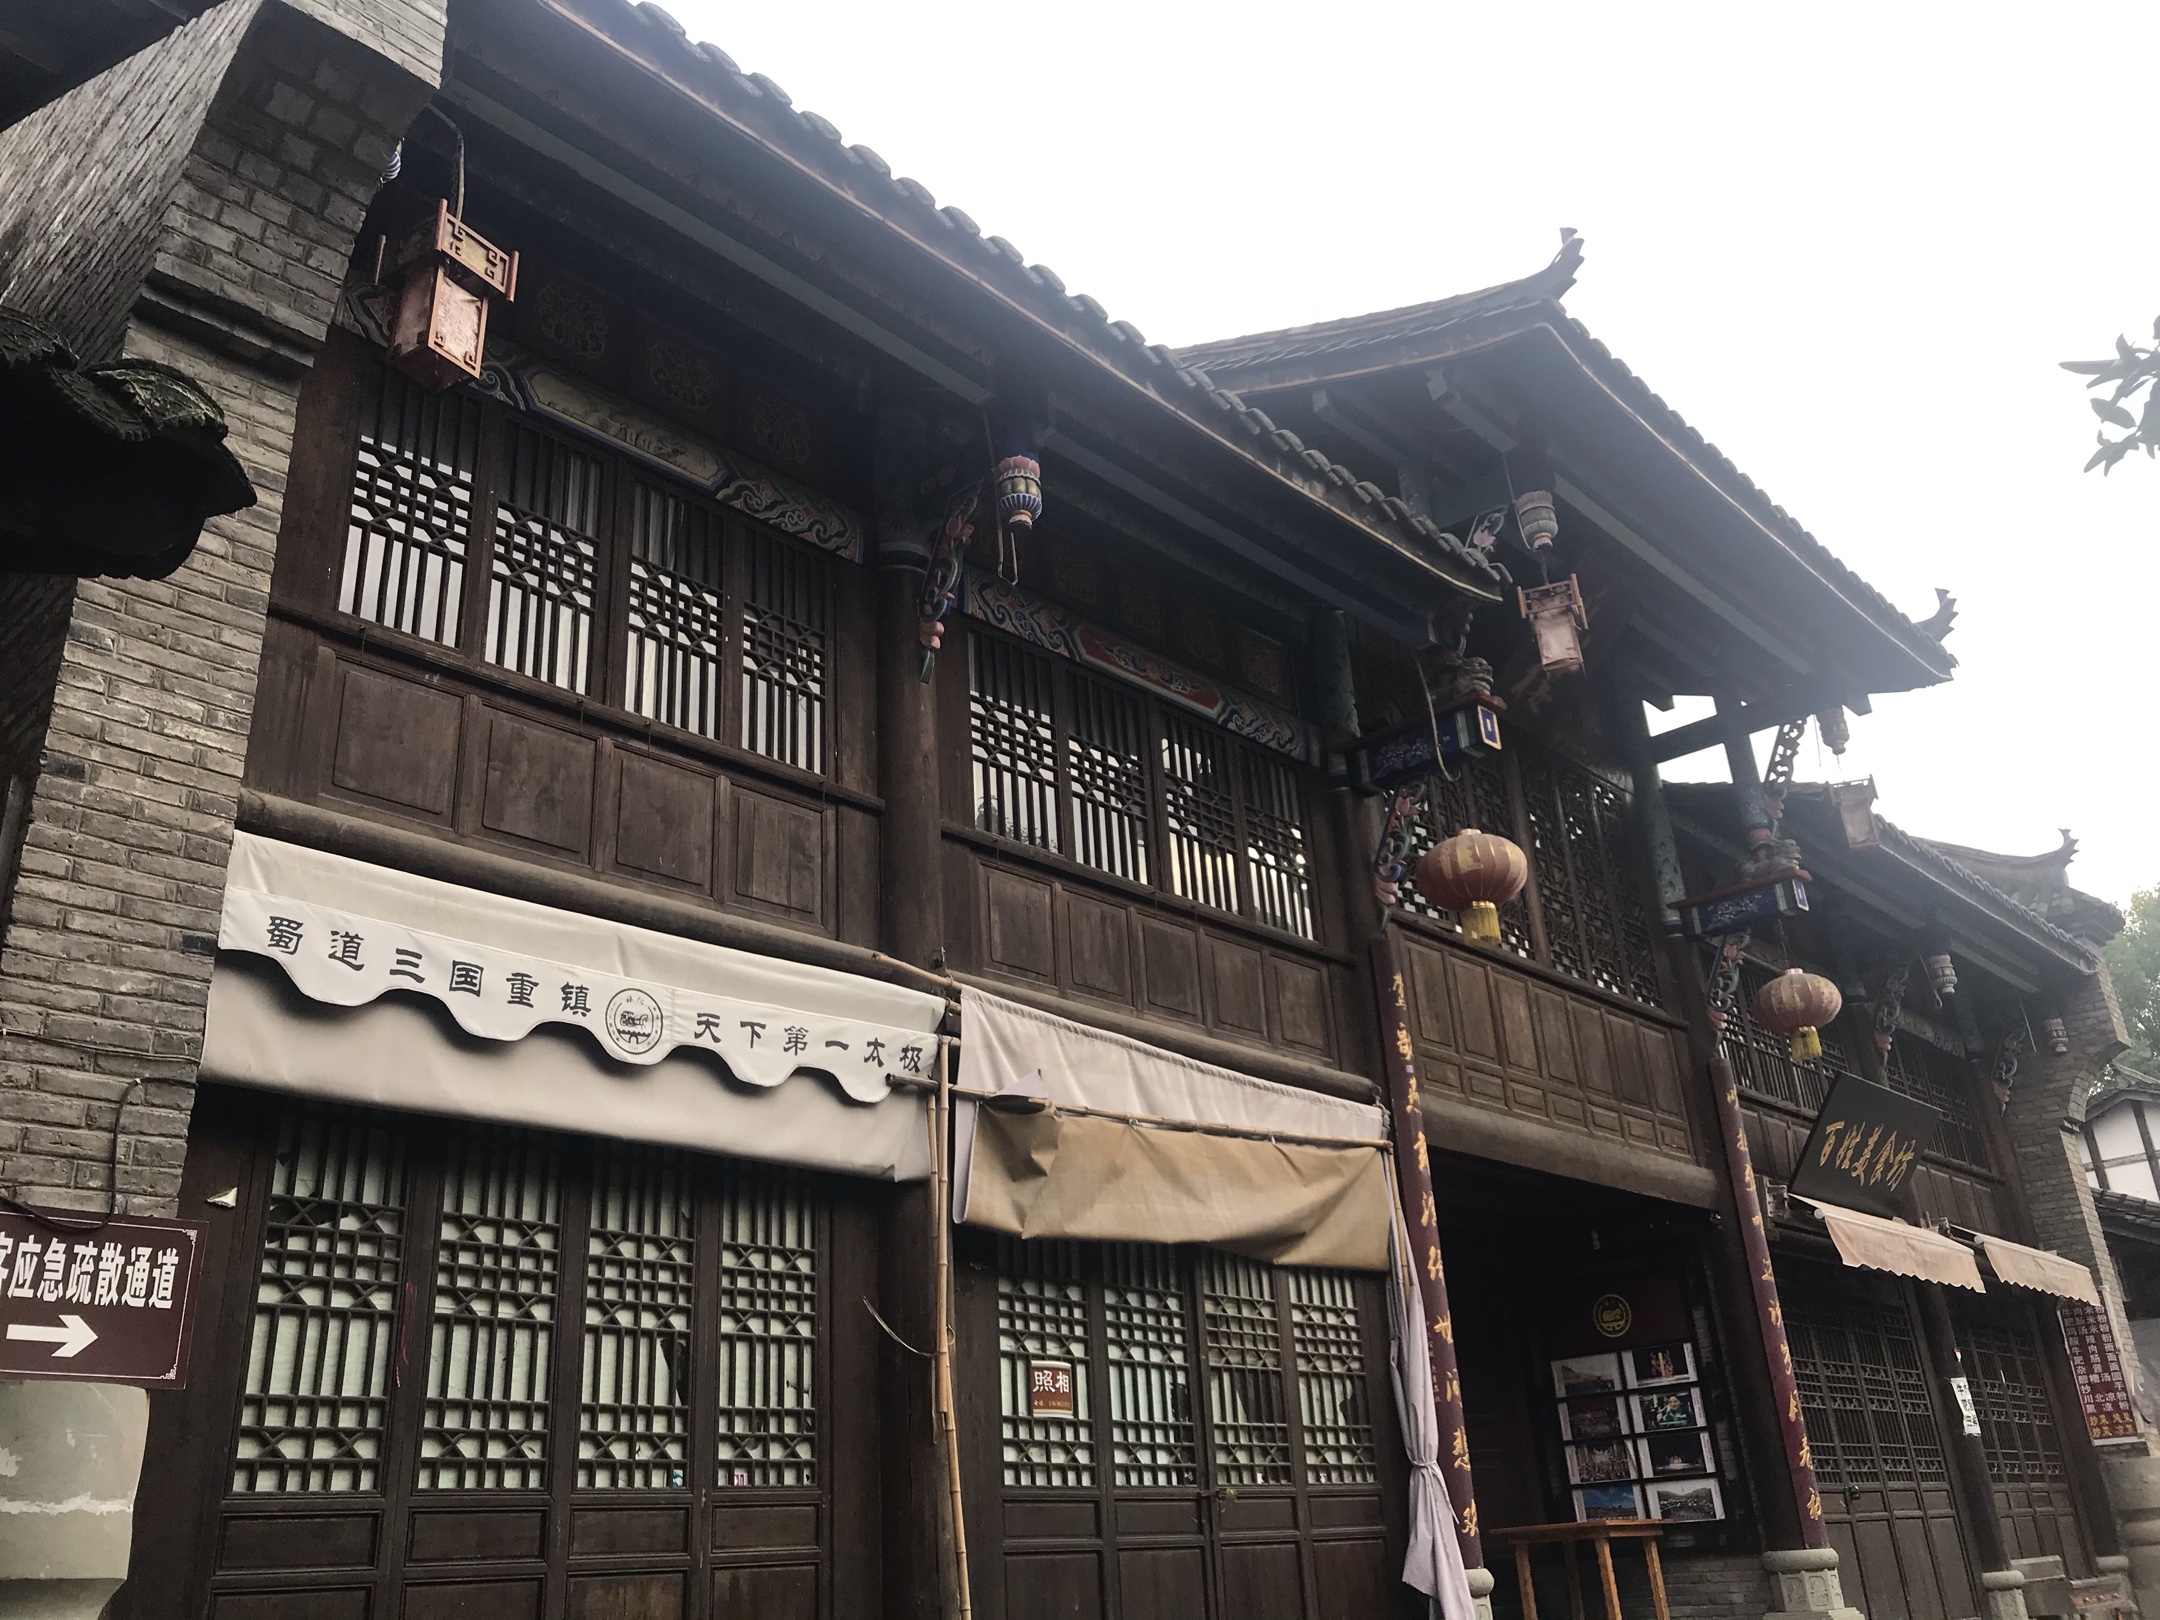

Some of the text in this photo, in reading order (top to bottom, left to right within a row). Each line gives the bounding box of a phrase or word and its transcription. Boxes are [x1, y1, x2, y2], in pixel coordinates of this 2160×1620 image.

[266, 915, 592, 1018] 蜀道三国重镇
[693, 1011, 924, 1074] 天下第一太极
[1032, 1369, 1070, 1394] 照相
